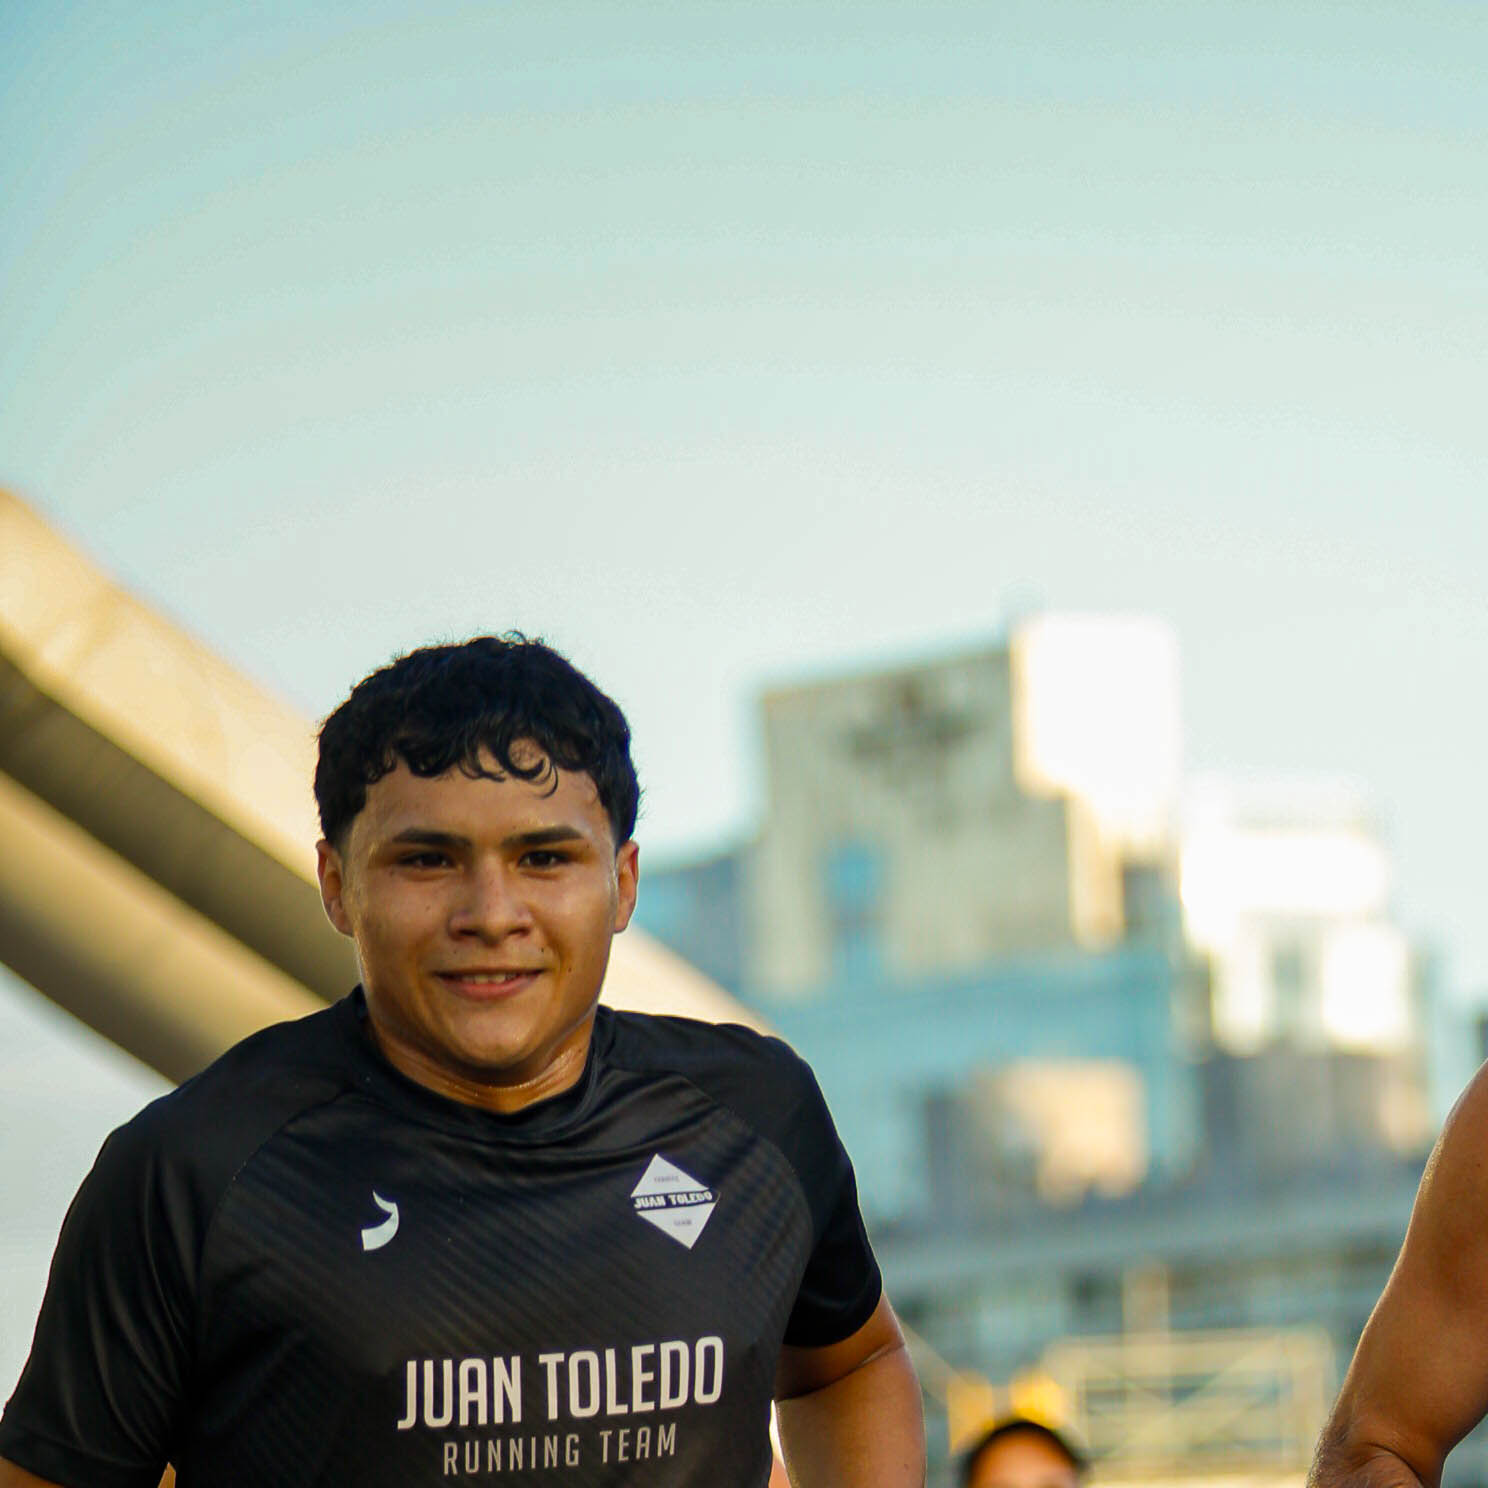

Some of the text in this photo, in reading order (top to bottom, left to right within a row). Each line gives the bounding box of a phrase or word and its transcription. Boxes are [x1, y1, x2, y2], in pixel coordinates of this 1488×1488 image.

[633, 1191, 713, 1209] JUAN TOLEDO
[397, 1335, 725, 1430] JUAN TOLEDO
[443, 1422, 677, 1476] RUNNING TEAM
